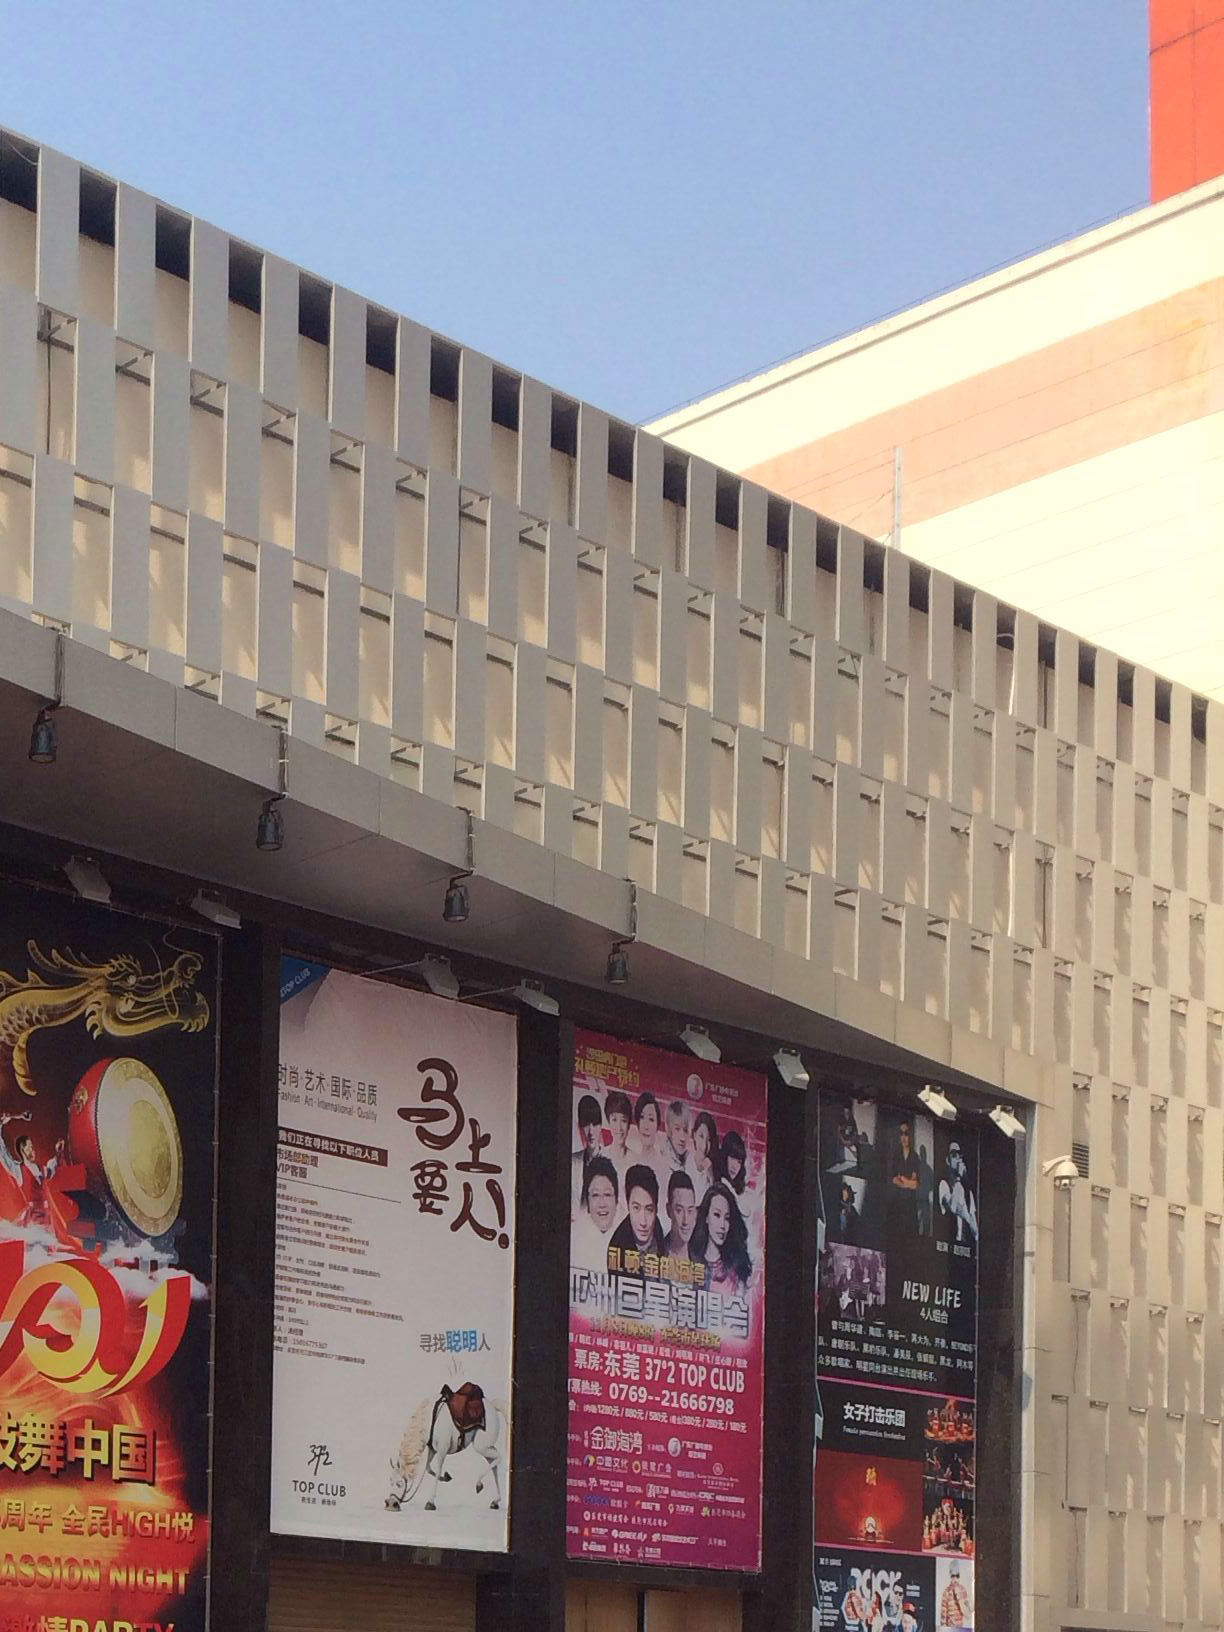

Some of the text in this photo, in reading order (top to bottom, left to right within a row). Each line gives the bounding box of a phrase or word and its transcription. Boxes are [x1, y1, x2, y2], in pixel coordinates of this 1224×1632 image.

[902, 1280, 962, 1309] NEW LIFE
[419, 1329, 491, 1352] 寻找聪明人
[679, 1361, 707, 1388] TOP
[710, 1367, 745, 1394] CLUB
[842, 1402, 907, 1428] 女子打击乐团
[292, 1480, 347, 1498] TOP CLUB
[109, 1564, 190, 1598] NIGHT
